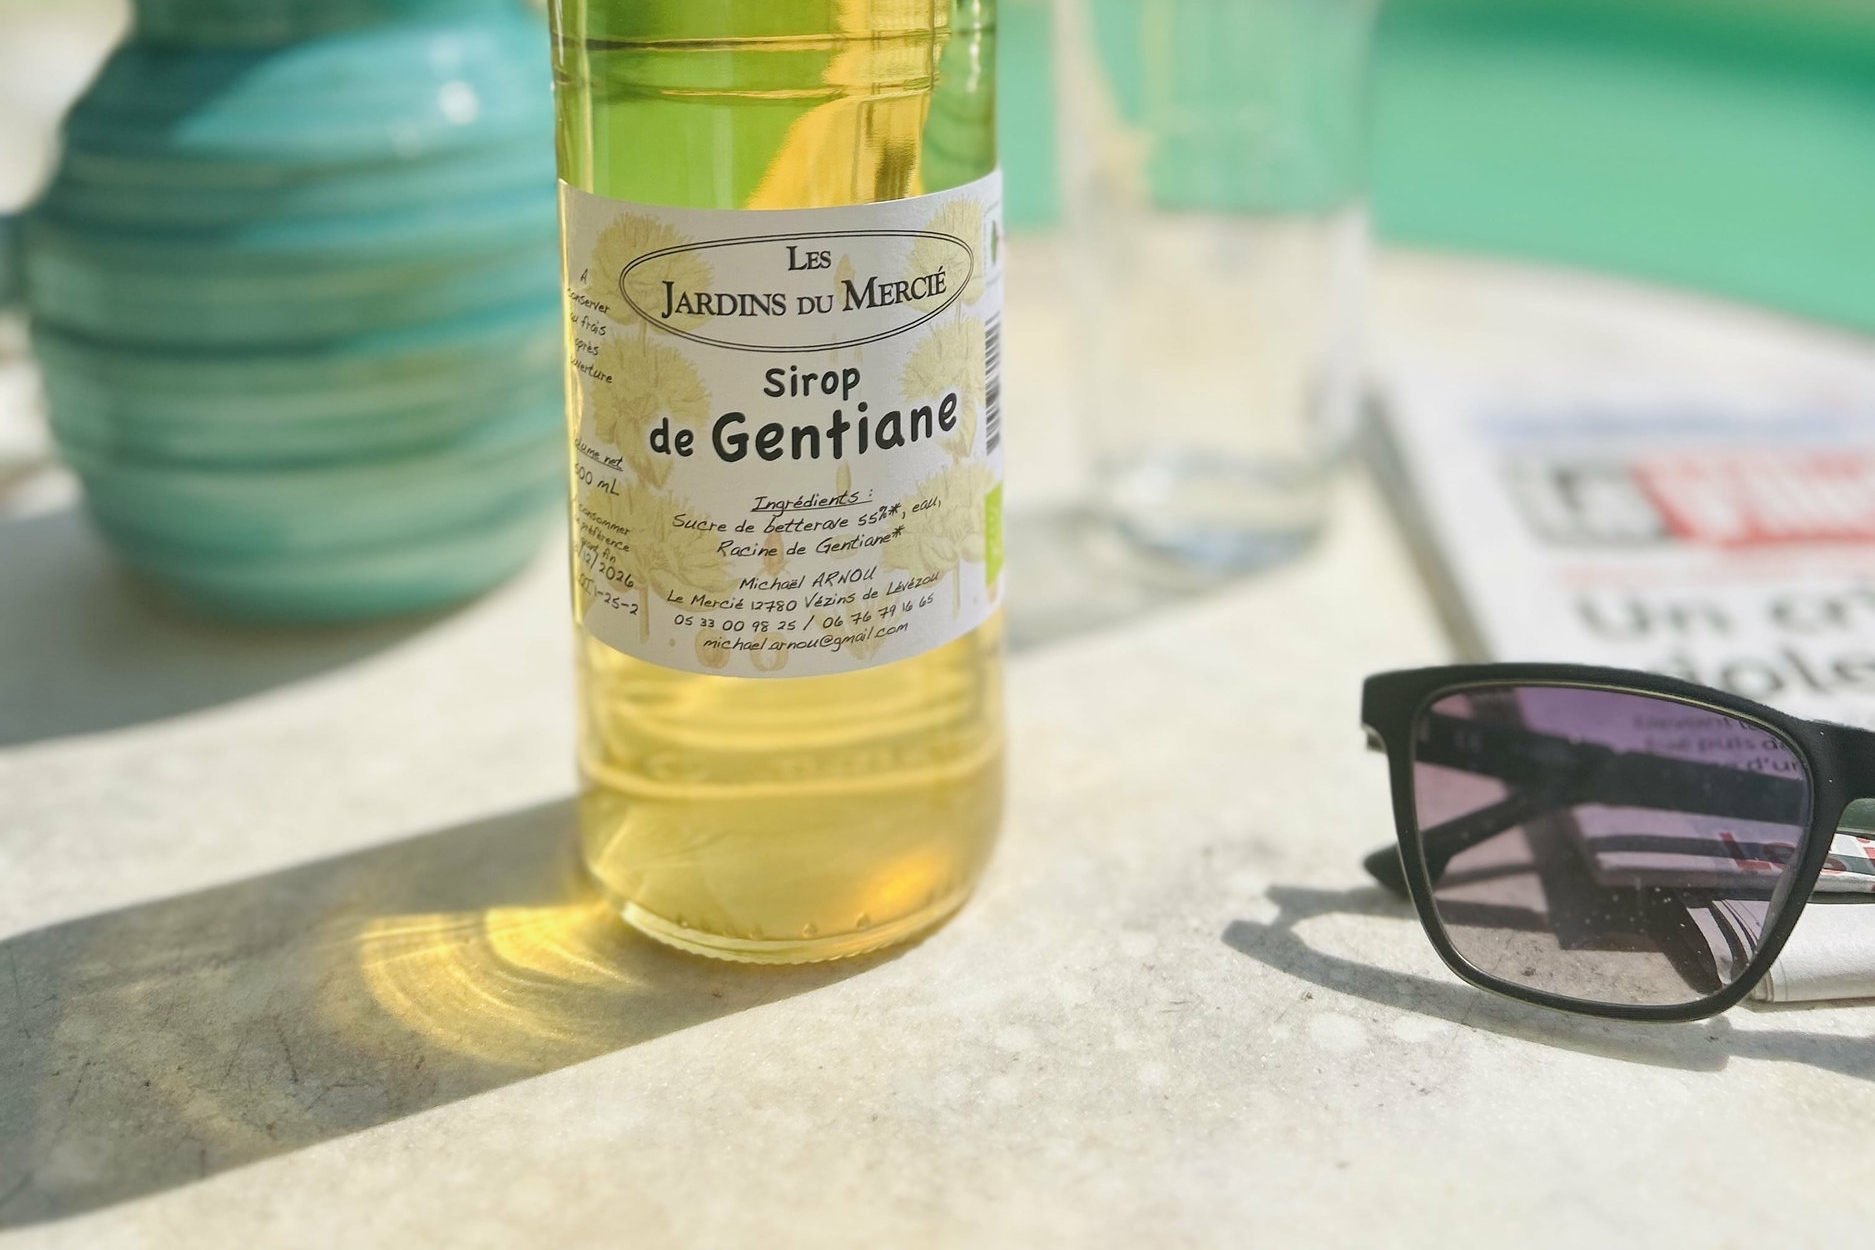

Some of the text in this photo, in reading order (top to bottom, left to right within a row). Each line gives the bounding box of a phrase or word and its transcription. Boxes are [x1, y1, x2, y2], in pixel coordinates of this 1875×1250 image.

[581, 315, 607, 337] frais
[763, 365, 861, 401] Sirop
[649, 392, 958, 463] de Gentiane
[603, 456, 624, 469] net
[597, 478, 620, 497] mL
[672, 513, 727, 532] Sucre
[735, 519, 755, 533] de
[763, 515, 849, 534] betterave
[912, 496, 942, 513] eau,
[751, 490, 860, 518] Ingrédients
[602, 548, 617, 565] fin
[716, 539, 778, 557] Racine
[786, 541, 807, 556] de
[739, 565, 878, 591] Michaël ARNOU
[667, 588, 684, 604] Le
[690, 594, 744, 610] Mercié
[750, 600, 798, 613] 12780
[804, 592, 856, 610] Vézins
[862, 587, 879, 601] de
[673, 613, 694, 626] 05
[699, 617, 715, 628] 33
[722, 619, 745, 632] 00
[751, 620, 769, 633] 98
[777, 620, 796, 631] 25
[822, 616, 844, 629] 06
[851, 610, 872, 625] 76
[878, 604, 897, 620] 79
[902, 603, 913, 613] 16
[918, 593, 934, 609] 65
